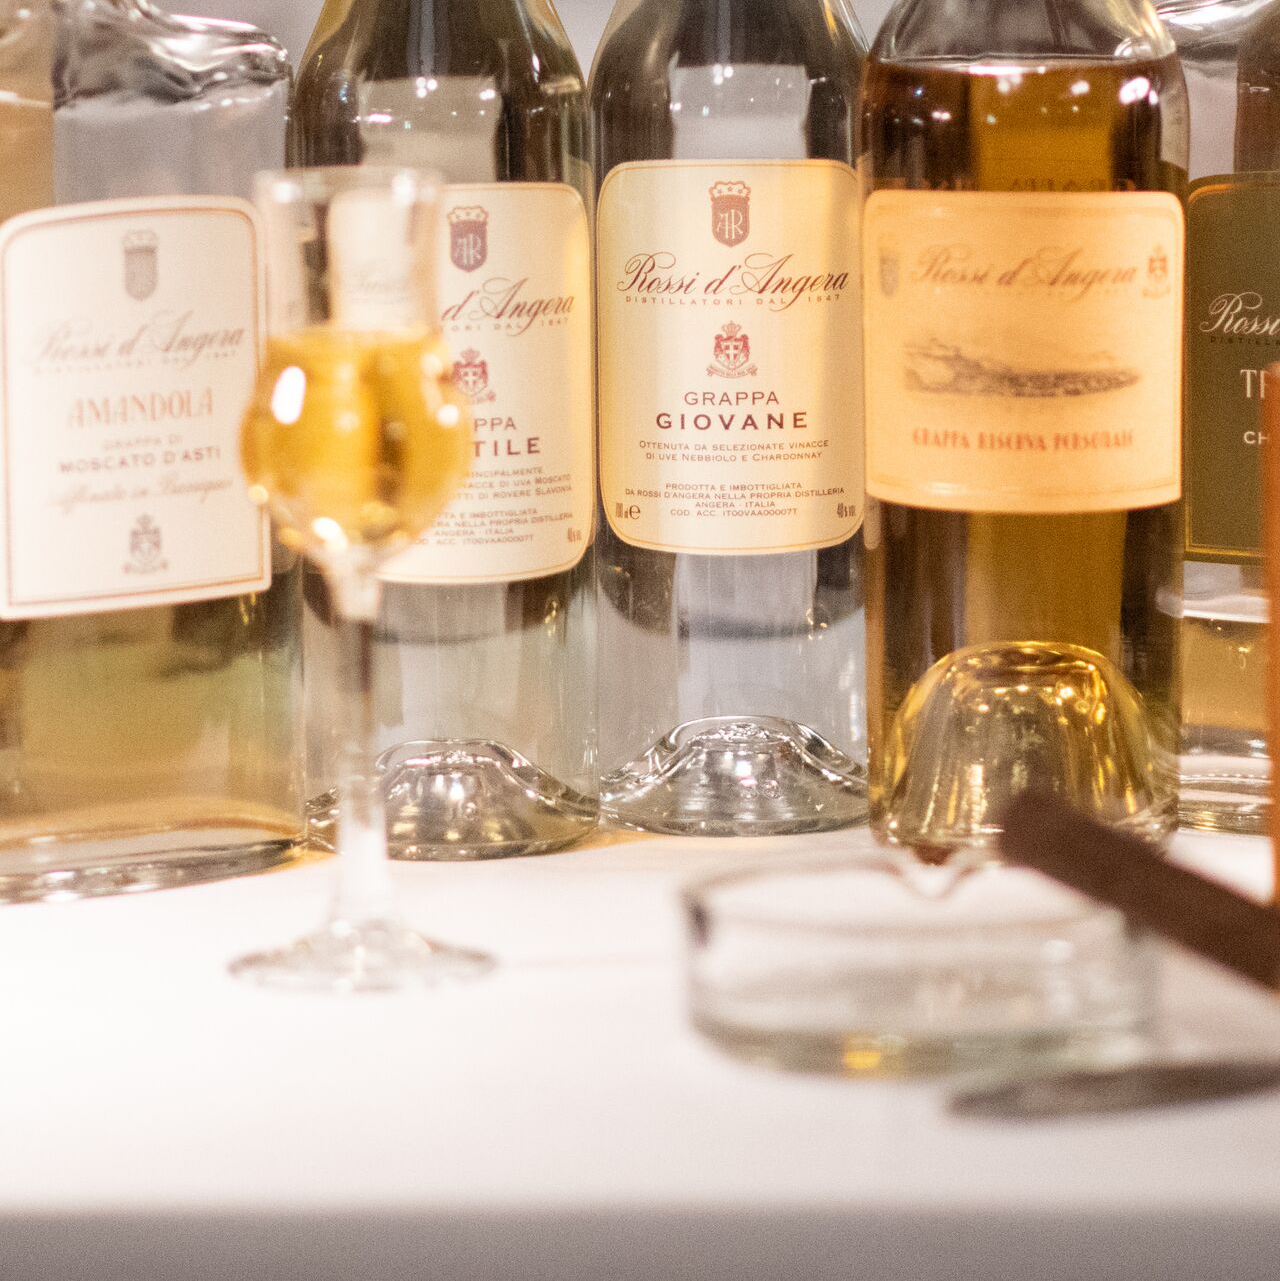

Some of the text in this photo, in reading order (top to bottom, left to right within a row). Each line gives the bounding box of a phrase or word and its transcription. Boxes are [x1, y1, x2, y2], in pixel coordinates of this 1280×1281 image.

[616, 251, 850, 313] Rossi d'Angera
[441, 276, 575, 337] d'Angera
[625, 295, 743, 306] DISTILLATORI
[67, 386, 214, 429] AMANDOLA
[683, 390, 780, 407] GRAPPA
[474, 416, 518, 433] PPA
[655, 411, 808, 431] GIOVANE
[473, 436, 541, 458] TILE
[712, 443, 785, 452] SELEZIONATE
[789, 439, 830, 450] VINACCE
